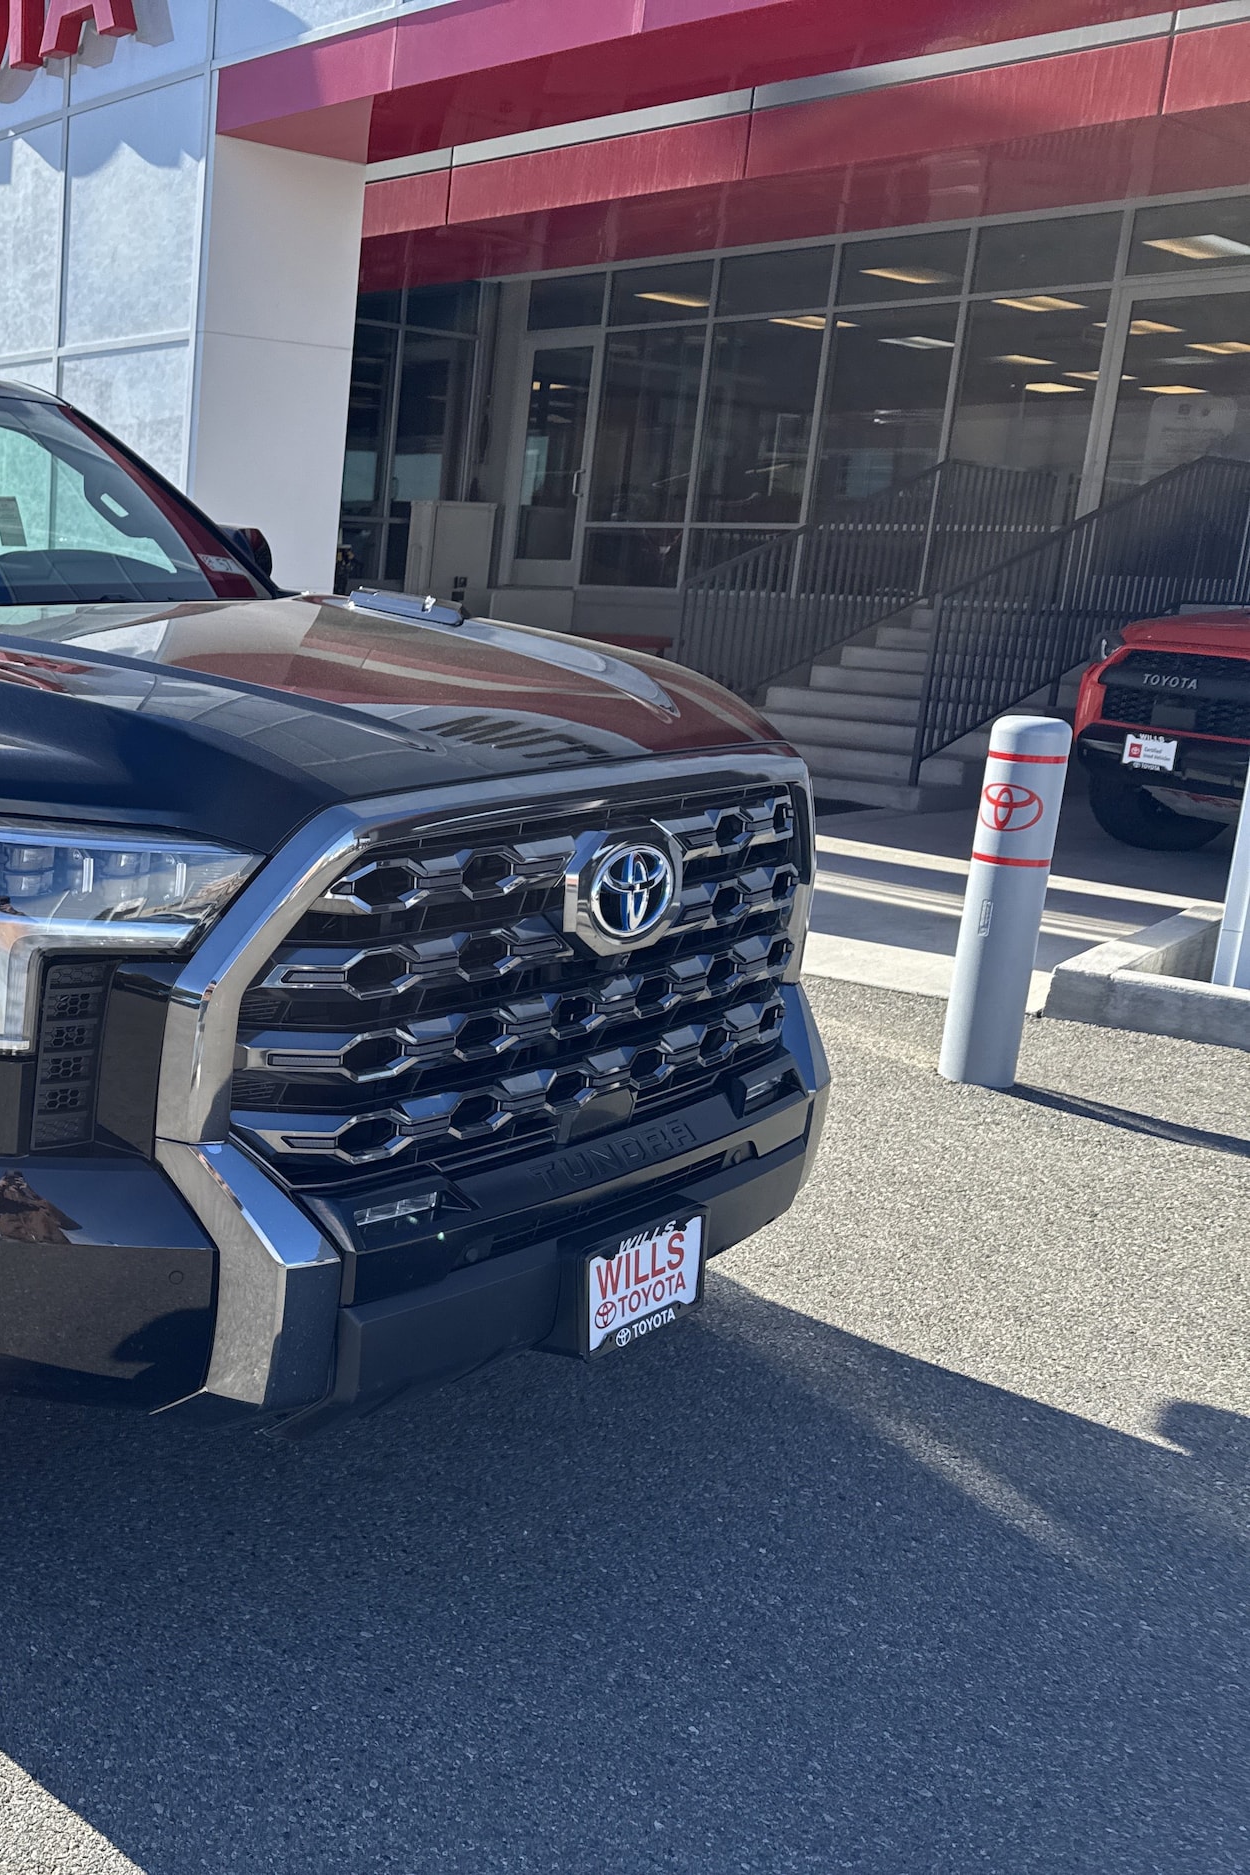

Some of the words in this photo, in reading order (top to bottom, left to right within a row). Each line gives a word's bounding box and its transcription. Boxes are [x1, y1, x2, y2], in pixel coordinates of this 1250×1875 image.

[1143, 673, 1198, 690] TOYOTA
[527, 1119, 698, 1192] TUNDRA
[618, 1220, 677, 1256] WILLS
[596, 1232, 685, 1301] WILLS
[618, 1271, 687, 1318] TOYOTA
[632, 1307, 676, 1338] TOYOTA
